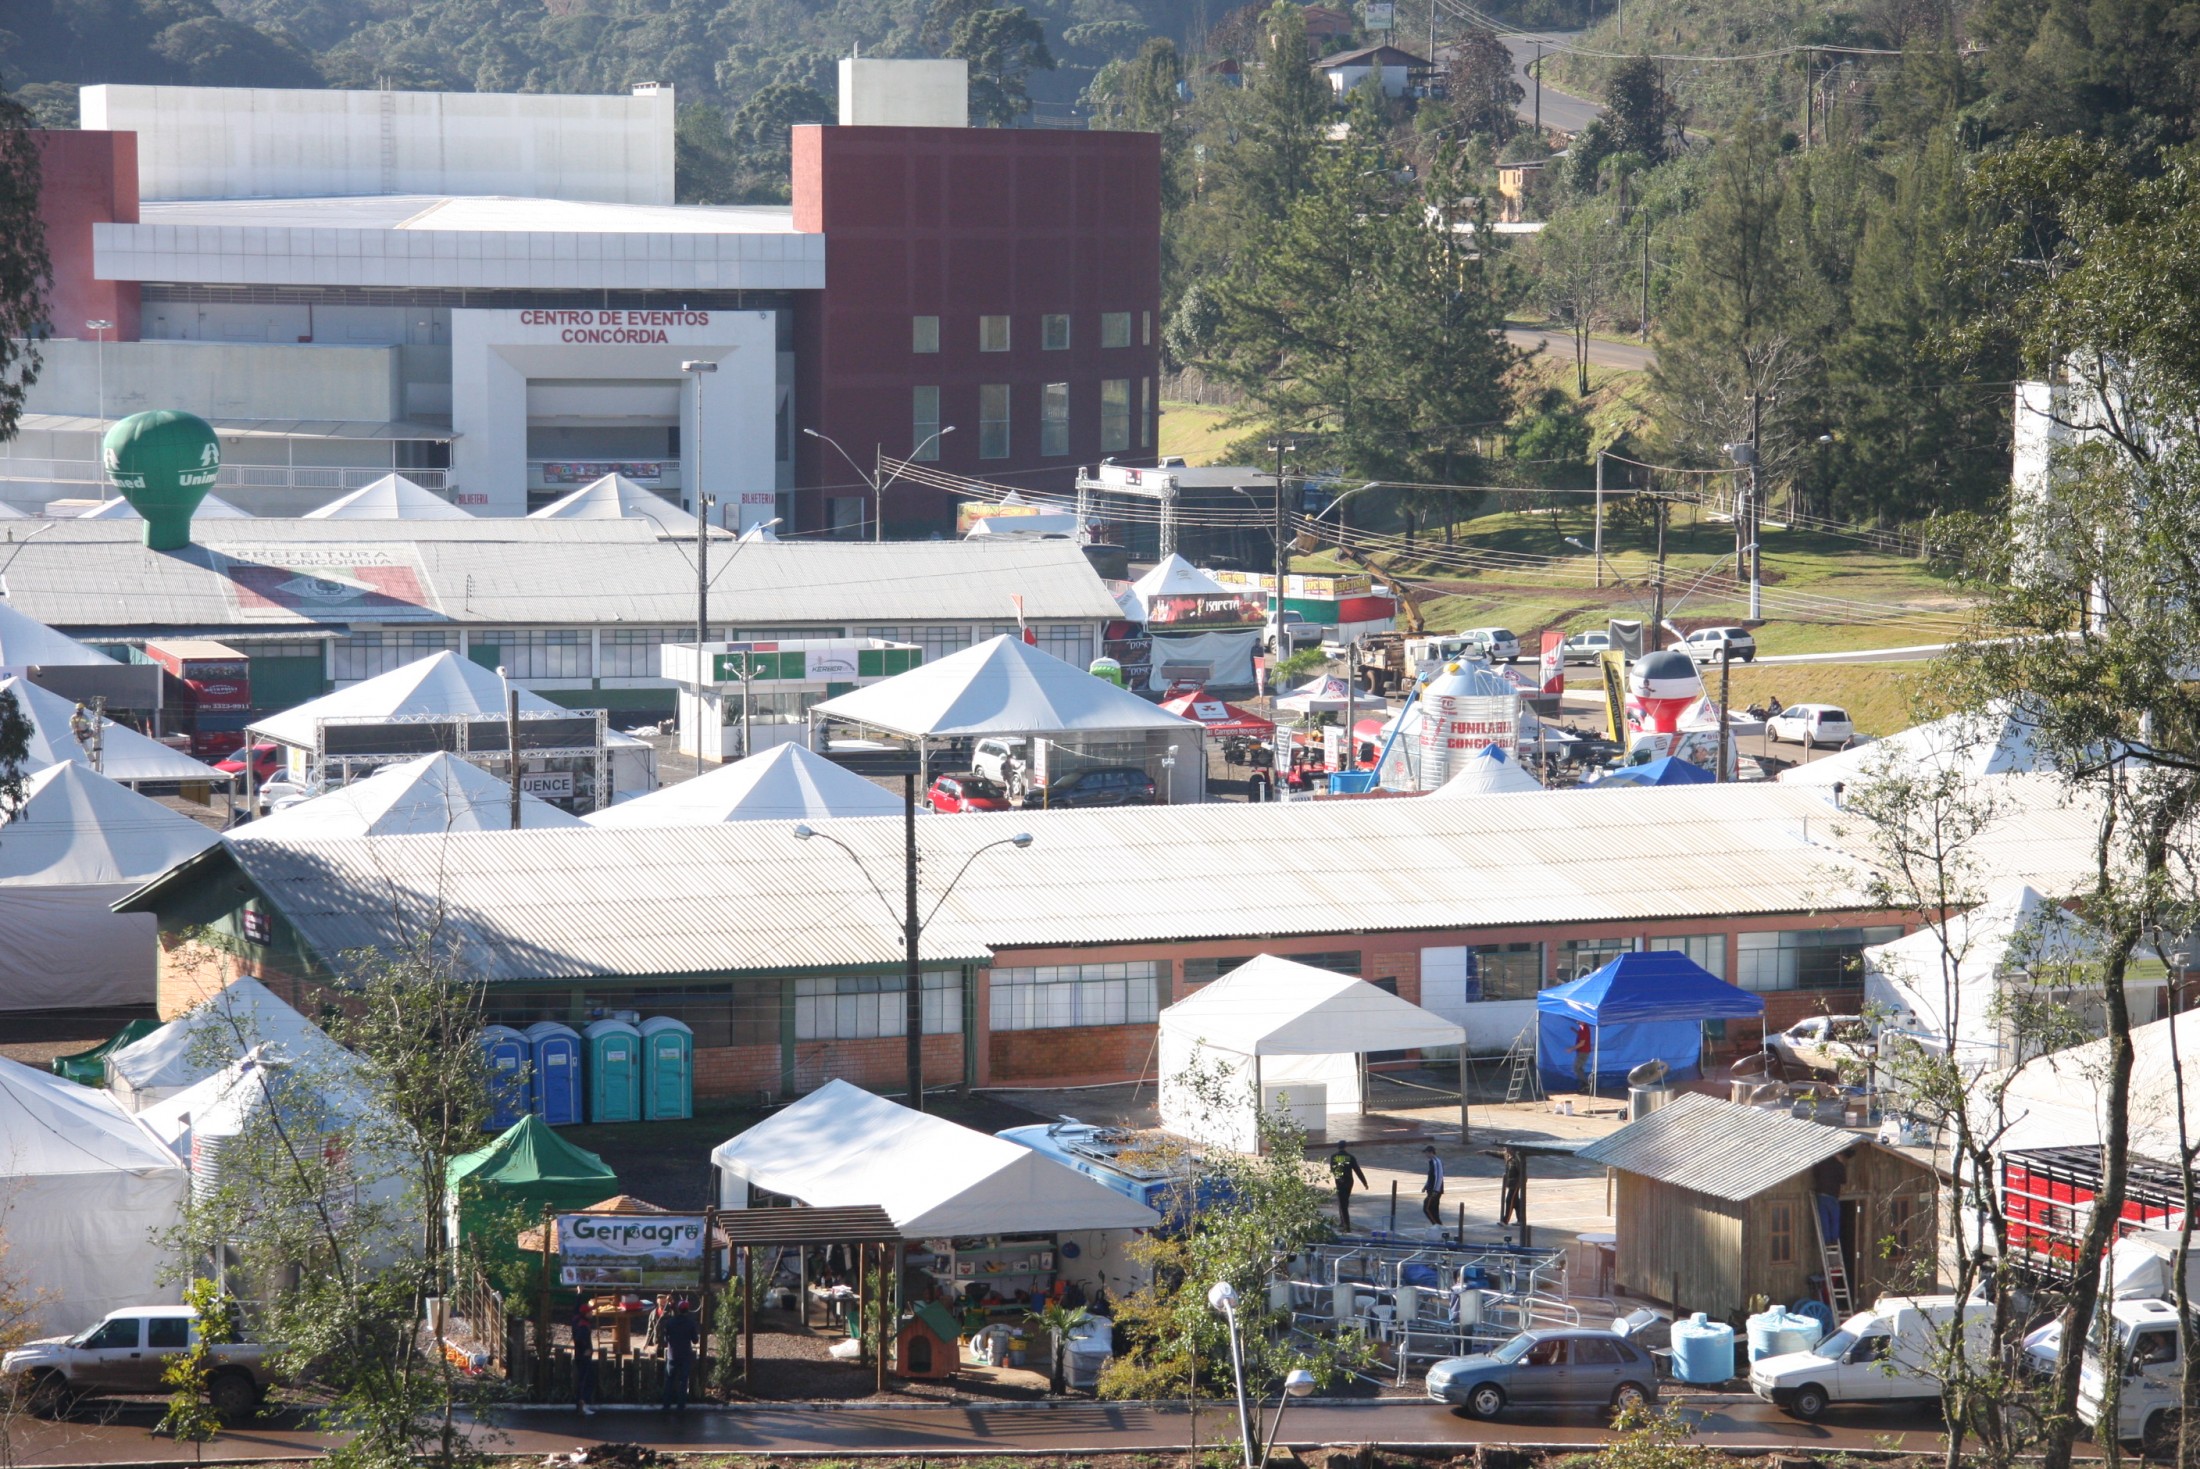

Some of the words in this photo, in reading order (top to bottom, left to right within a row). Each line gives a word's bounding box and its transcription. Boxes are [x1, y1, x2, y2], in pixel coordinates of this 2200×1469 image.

[520, 310, 594, 326] CENTRO
[599, 311, 623, 326] DE
[628, 311, 710, 327] EVENTOS
[561, 327, 669, 344] CONCÓRDIA
[179, 472, 218, 486] Unim
[458, 493, 489, 505] BILHETERIA
[741, 492, 775, 504] BILHETERIA
[236, 551, 390, 559] PREFEITURA
[523, 778, 571, 792] UENCE
[572, 1217, 699, 1247] Gerpagro
